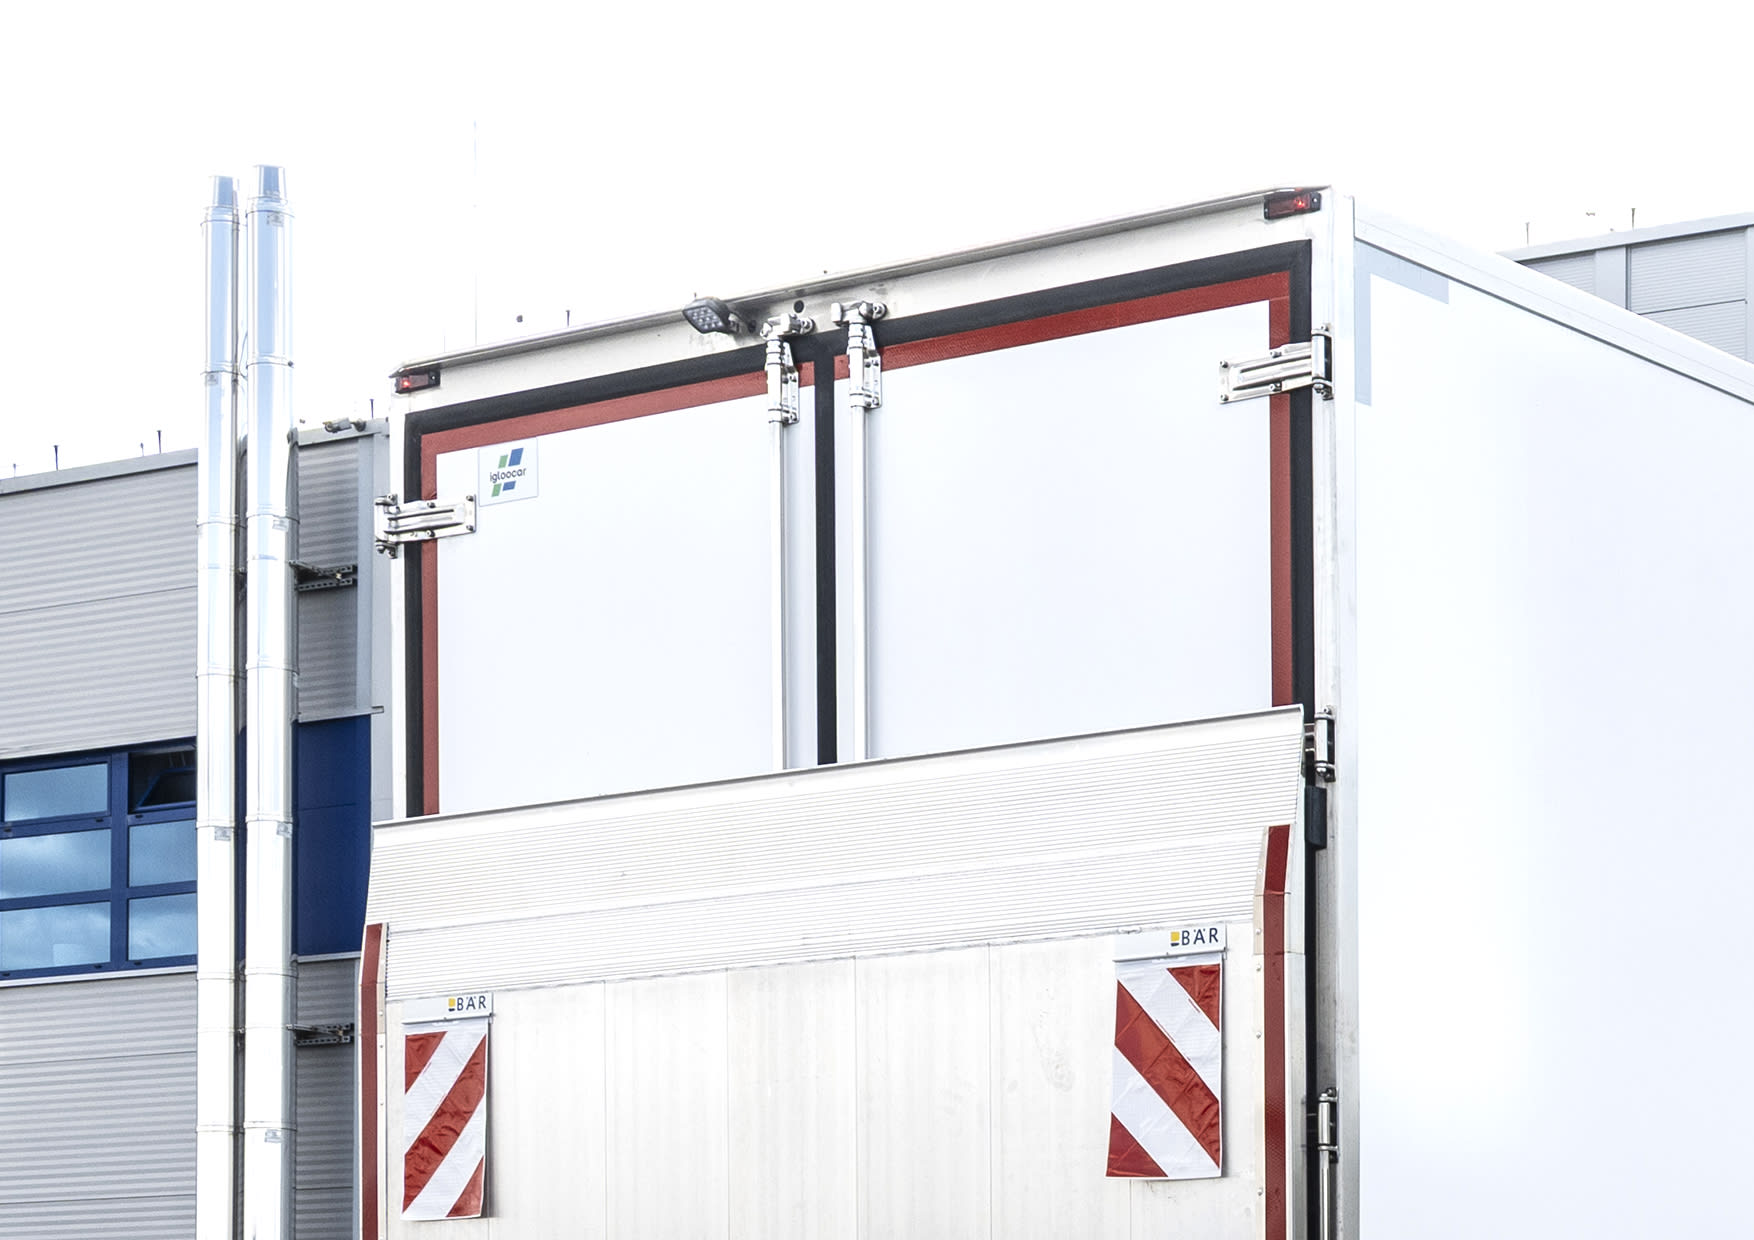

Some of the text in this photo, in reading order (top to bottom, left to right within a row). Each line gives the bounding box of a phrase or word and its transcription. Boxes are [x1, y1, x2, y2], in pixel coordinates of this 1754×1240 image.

[489, 467, 527, 484] igloocar
[1181, 927, 1219, 946] BÄR
[456, 995, 487, 1011] BÄR
